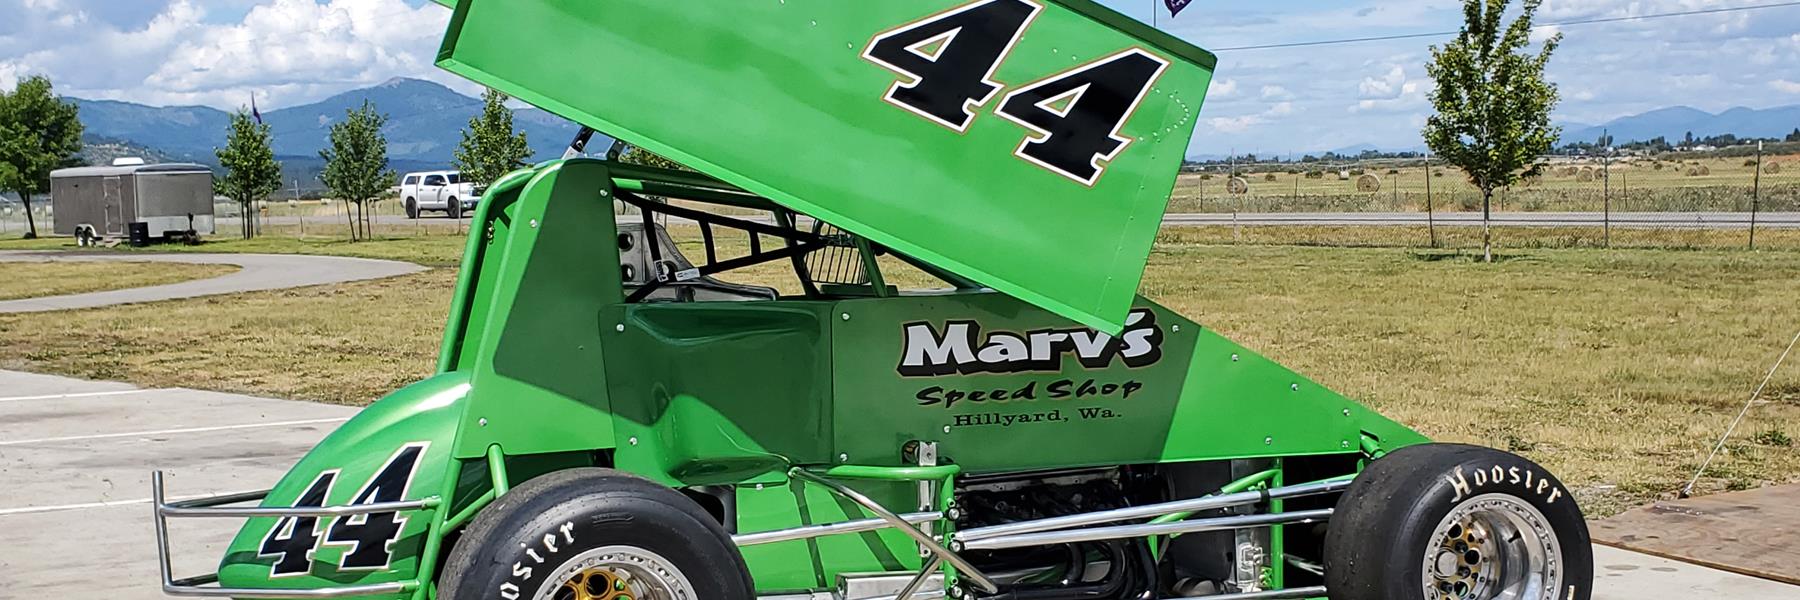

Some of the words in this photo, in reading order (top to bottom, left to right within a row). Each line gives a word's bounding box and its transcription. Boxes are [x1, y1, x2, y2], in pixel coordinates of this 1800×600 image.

[861, 0, 1172, 188] 44
[897, 307, 1164, 377] Marv's
[915, 380, 1037, 408] Speed
[1046, 378, 1143, 399] Shop
[953, 409, 1069, 427] Hillyard,
[1078, 407, 1122, 420] Wa.
[257, 440, 433, 580] 44
[1445, 464, 1563, 503] Hoosier
